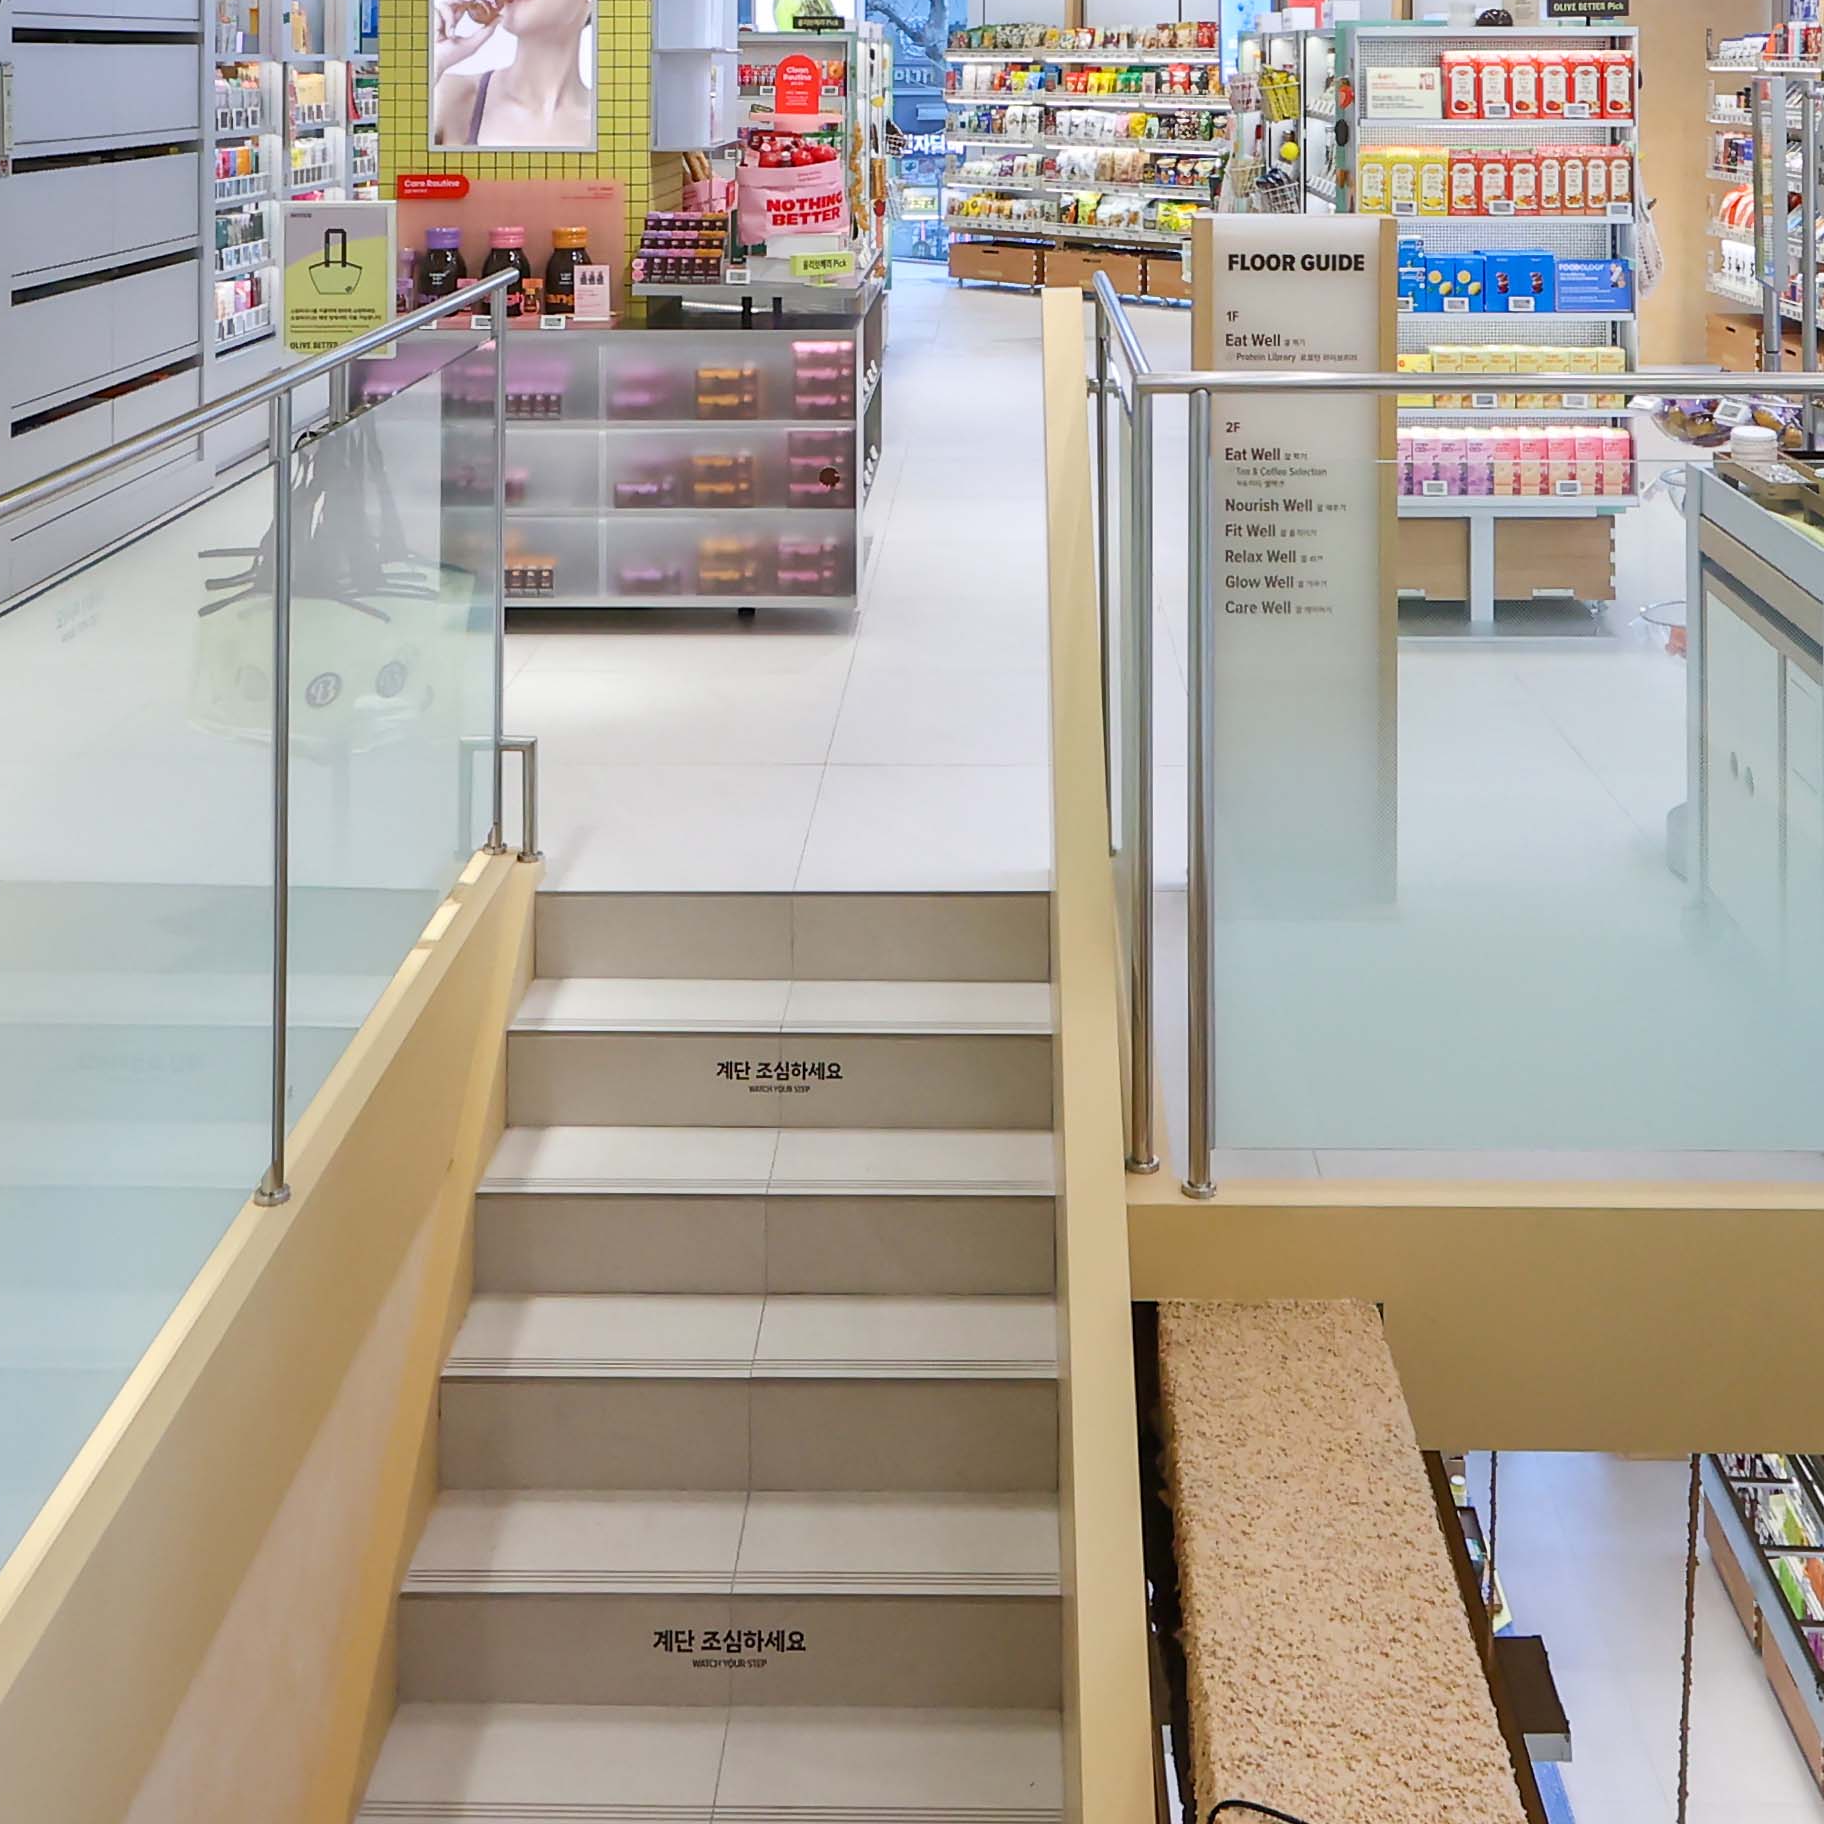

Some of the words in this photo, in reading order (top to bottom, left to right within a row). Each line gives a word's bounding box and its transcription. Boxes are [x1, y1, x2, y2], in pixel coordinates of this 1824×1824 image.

[1554, 2, 1577, 13] OLIVE
[1578, 1, 1606, 12] BETTER
[1607, 1, 1625, 11] Pick
[766, 191, 843, 213] NOTHING
[771, 206, 840, 226] BETTER
[832, 258, 847, 269] Pick
[1228, 254, 1296, 272] FLOOR
[1300, 254, 1365, 272] GUIDE
[1226, 310, 1239, 322] 1F
[1225, 334, 1248, 347] Eat
[1251, 334, 1280, 347] Well
[1268, 352, 1296, 363] Library
[1226, 422, 1241, 433] 2F
[1225, 448, 1247, 461] Eat
[1251, 448, 1281, 461] Well
[1260, 467, 1287, 476] Coffee
[1289, 467, 1327, 477] Selection
[1225, 498, 1279, 512] Nourish
[1283, 498, 1313, 512] Well
[1225, 524, 1242, 537] Fit
[1246, 524, 1276, 537] Well
[1225, 549, 1263, 563] Relax
[1267, 549, 1296, 563] Well
[1225, 575, 1260, 589] Glow
[1264, 575, 1294, 588] Well
[1225, 601, 1257, 614] Care
[1262, 601, 1291, 614] Well
[717, 1061, 751, 1080] 계단
[756, 1061, 843, 1081] 조심하세요
[653, 1629, 694, 1653] 계단
[701, 1629, 806, 1653] 조심하세요
[692, 1658, 721, 1669] WATCH
[723, 1658, 746, 1669] YOUR
[747, 1658, 768, 1669] STEP
